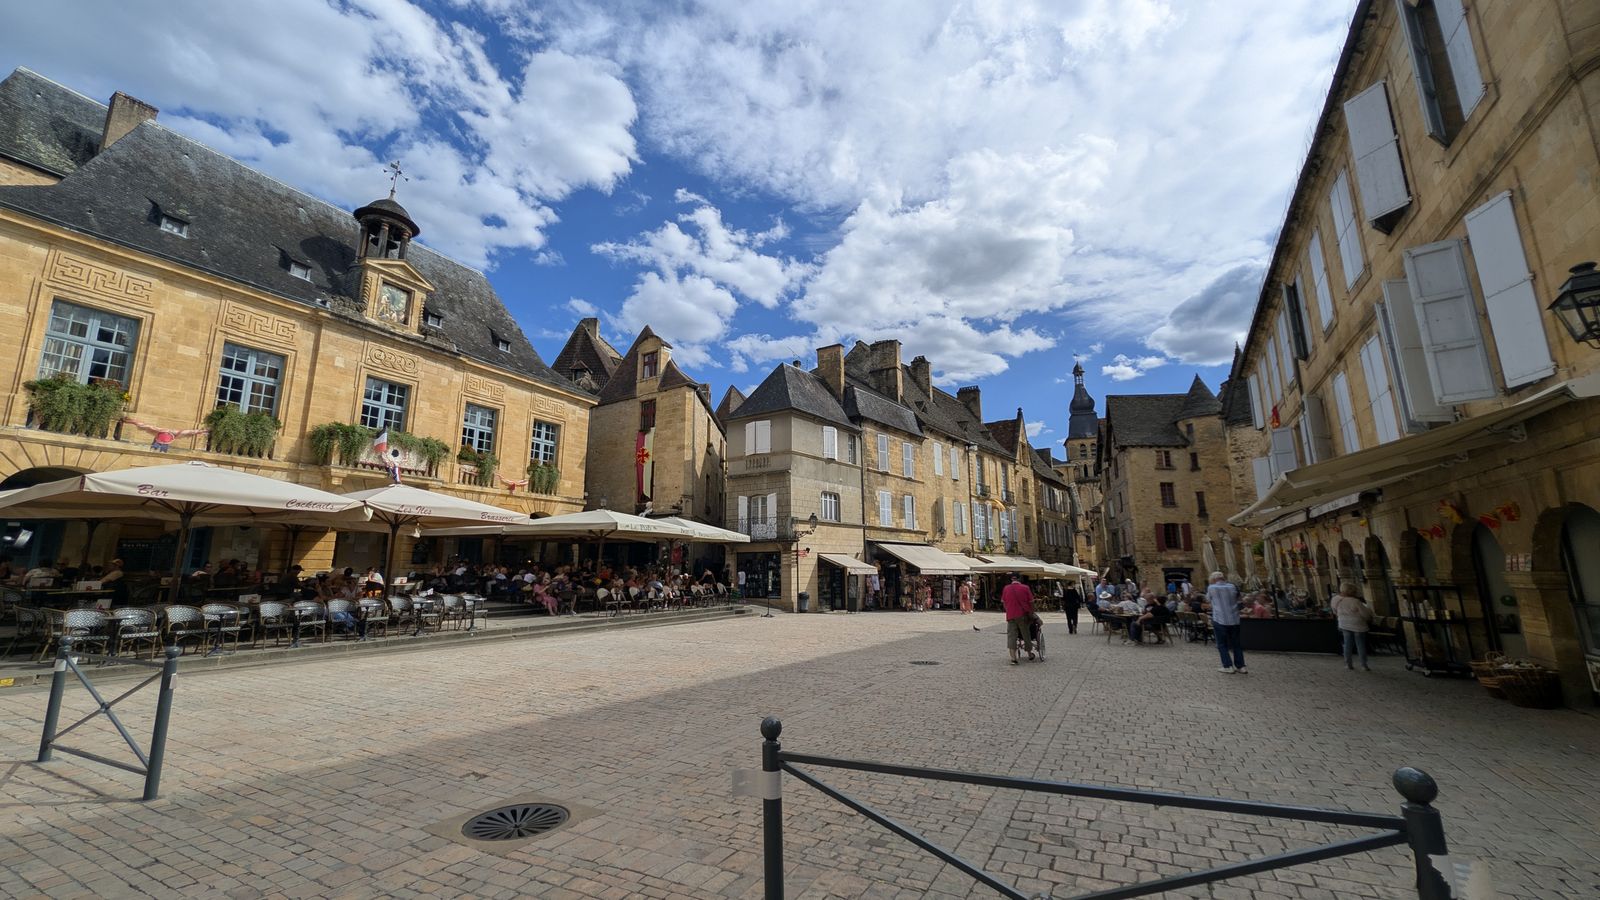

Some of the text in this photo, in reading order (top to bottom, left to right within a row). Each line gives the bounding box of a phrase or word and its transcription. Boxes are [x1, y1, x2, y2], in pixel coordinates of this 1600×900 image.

[137, 484, 169, 497] Bar
[286, 499, 334, 510] Cocktails
[395, 504, 412, 513] Les
